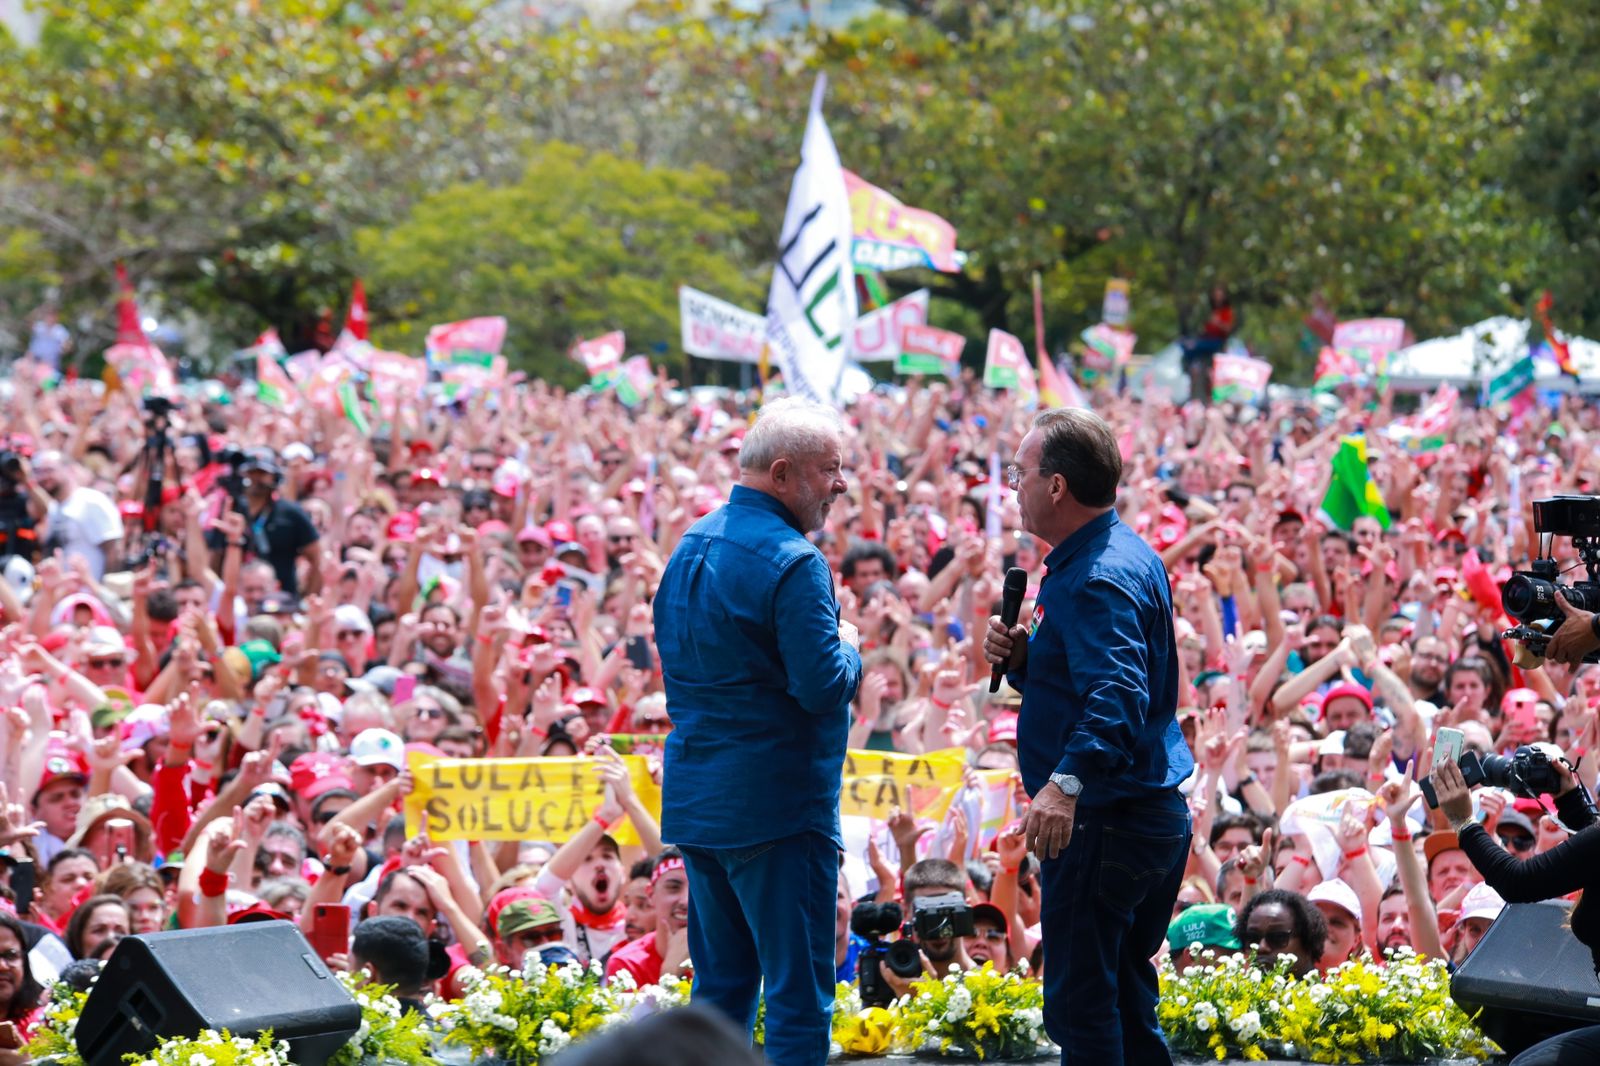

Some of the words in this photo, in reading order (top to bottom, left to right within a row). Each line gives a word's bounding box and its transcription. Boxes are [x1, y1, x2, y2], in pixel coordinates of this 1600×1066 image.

[432, 763, 547, 793] LULA
[1183, 921, 1206, 933] LULA
[1186, 930, 1206, 940] 2022
